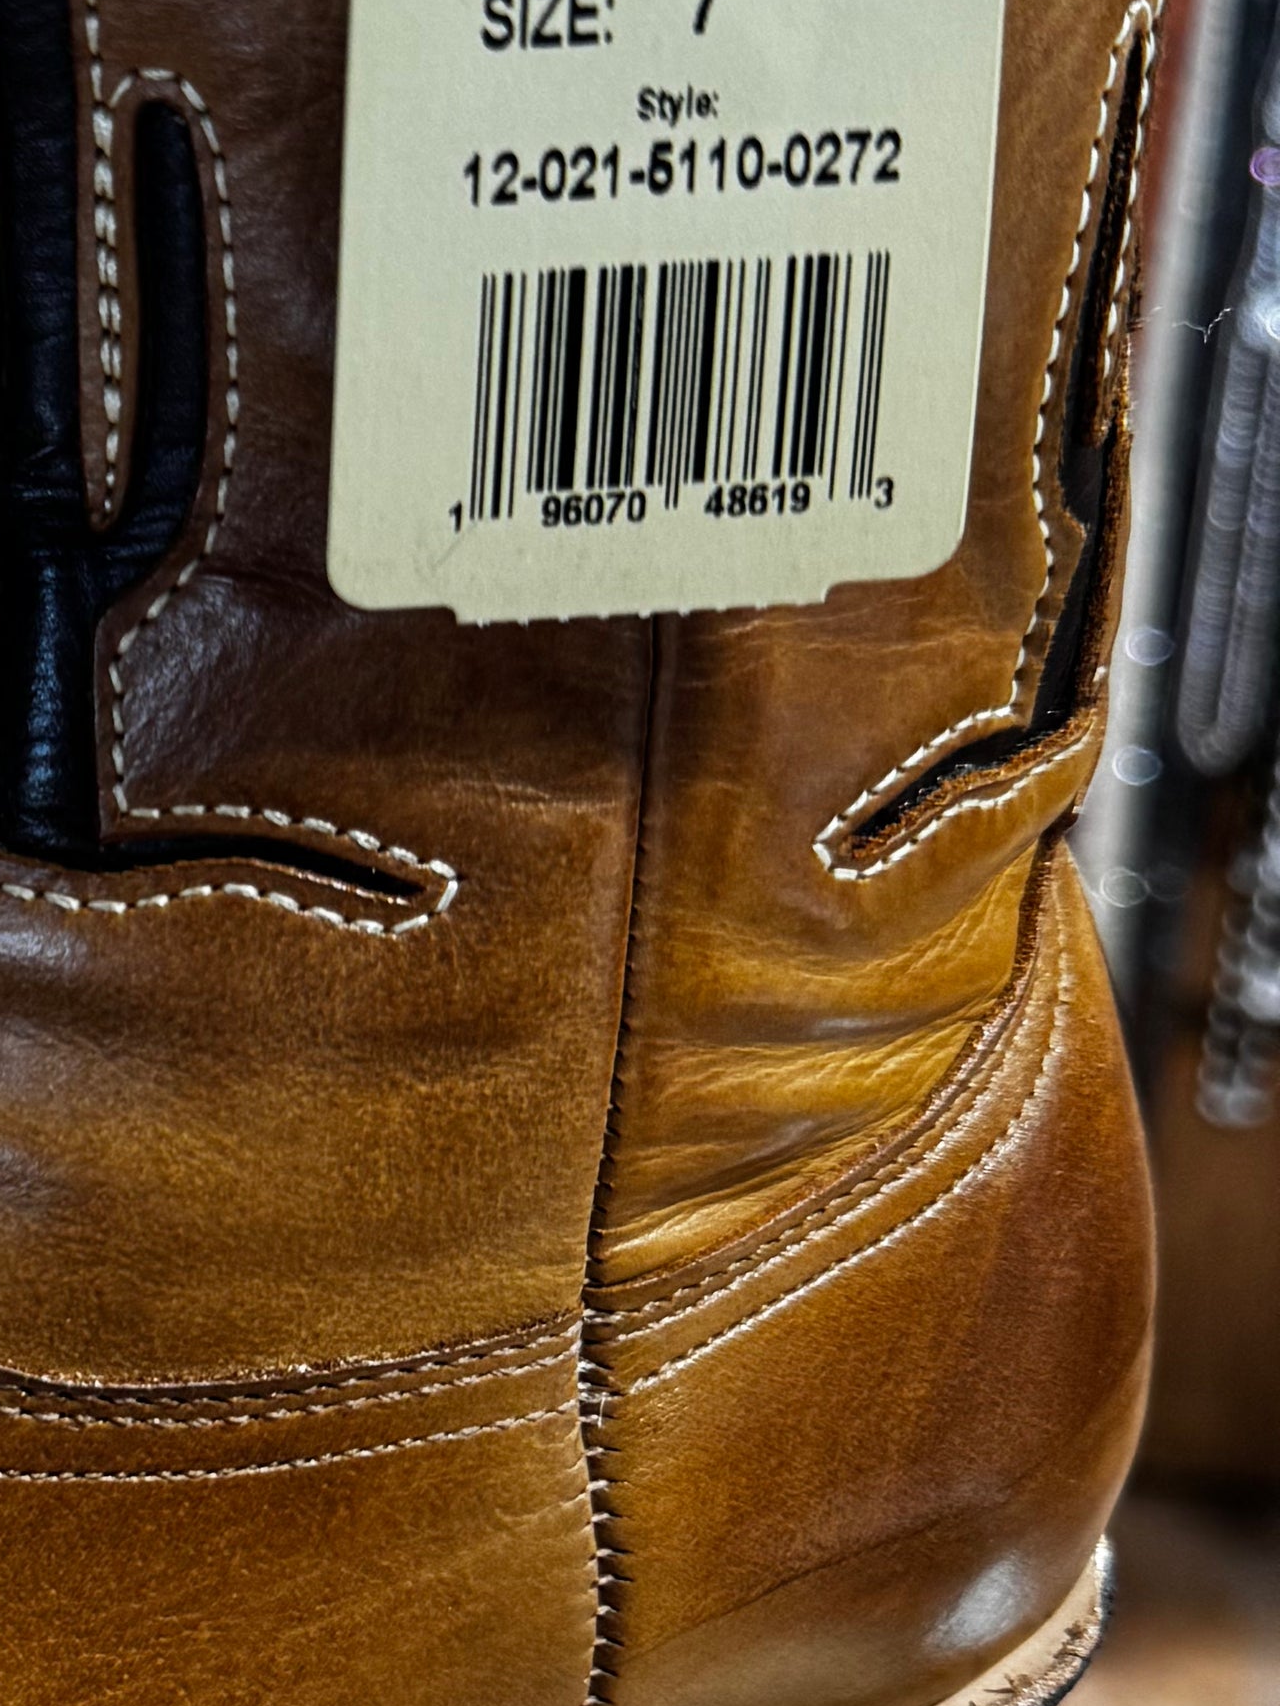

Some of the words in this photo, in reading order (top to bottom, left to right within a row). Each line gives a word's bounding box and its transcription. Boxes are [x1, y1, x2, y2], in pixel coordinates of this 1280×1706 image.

[636, 83, 721, 129] Style:
[447, 499, 465, 535] 1
[540, 495, 648, 529] 96070
[702, 484, 813, 520] 48619
[873, 475, 896, 511] 3
